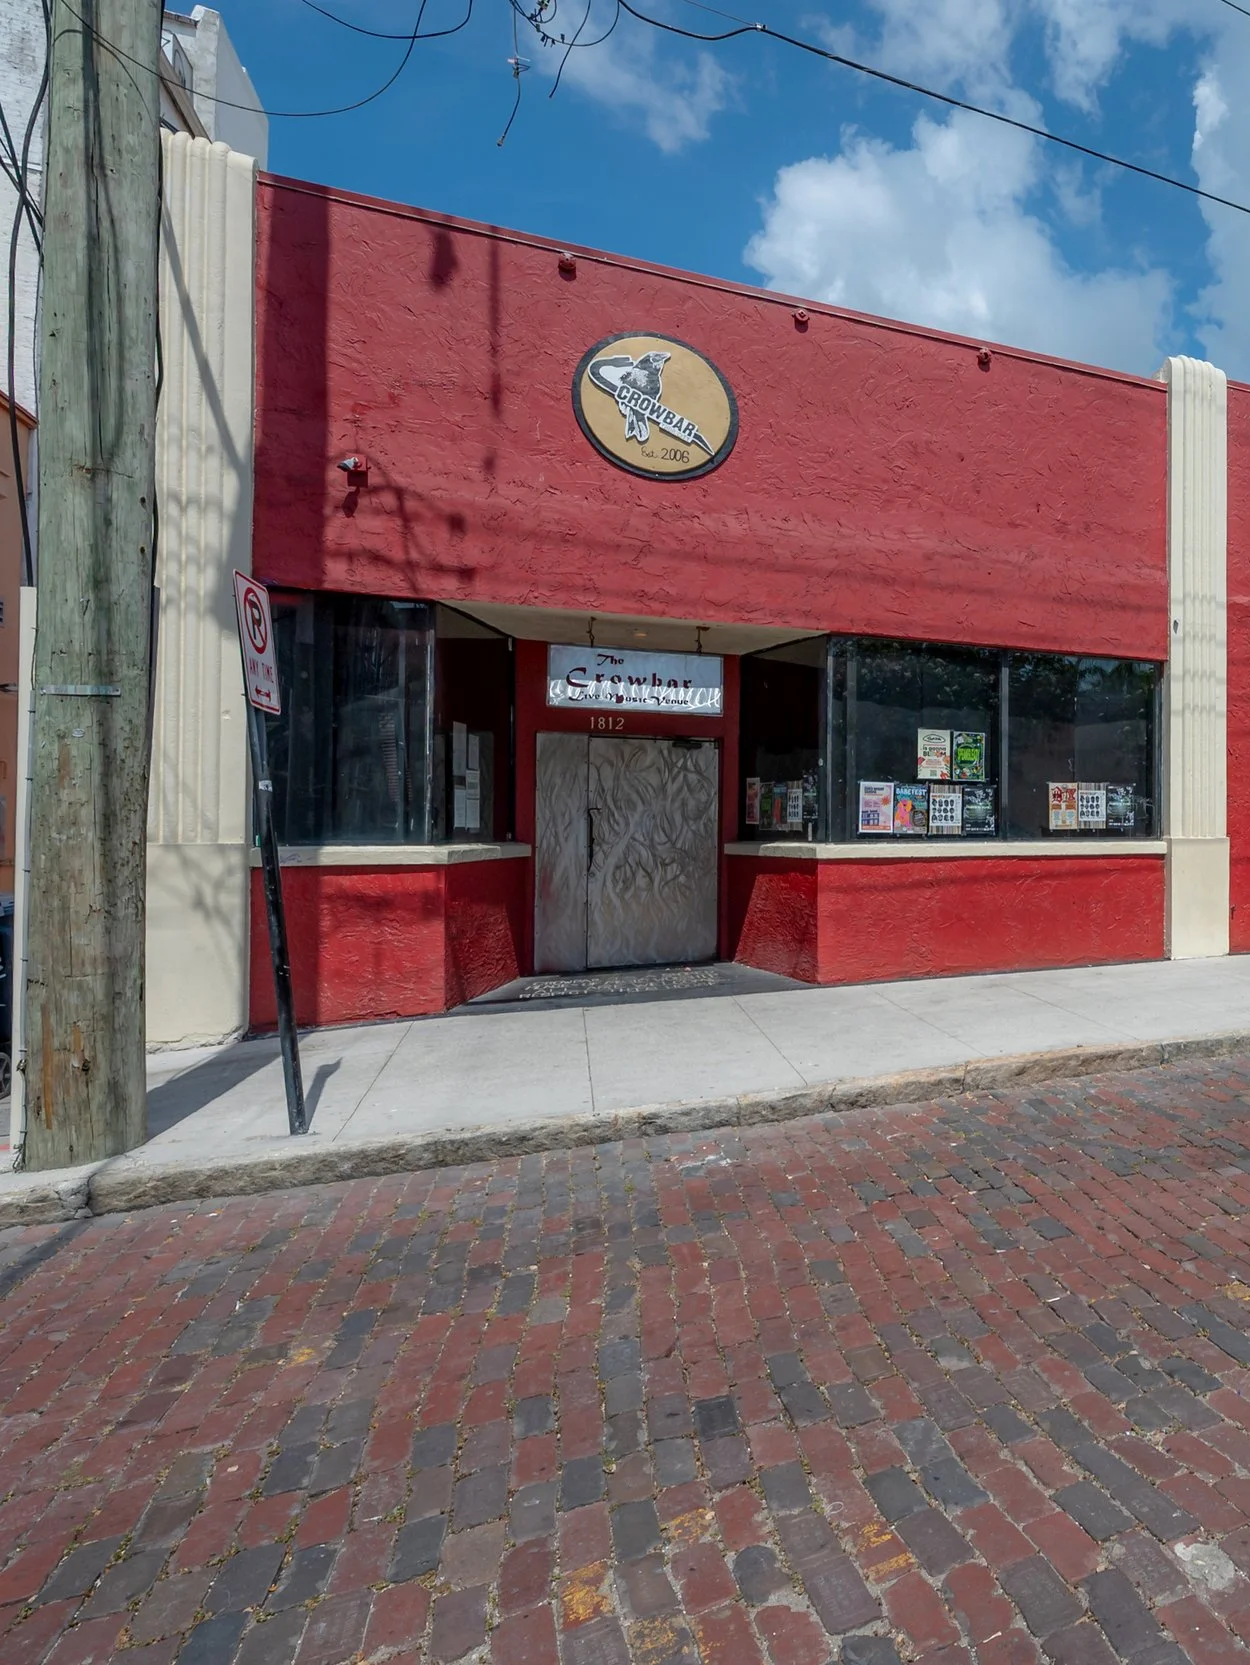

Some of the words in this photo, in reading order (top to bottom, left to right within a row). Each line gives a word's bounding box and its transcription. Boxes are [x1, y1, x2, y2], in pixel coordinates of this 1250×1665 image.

[617, 385, 698, 438] CROWBAR
[661, 448, 690, 463] 2006
[597, 653, 625, 666] The
[249, 657, 259, 678] ANY
[262, 662, 274, 684] TIME
[566, 667, 693, 689] Crowbar
[568, 690, 601, 702] Live
[650, 696, 689, 706] Venue
[589, 717, 625, 730] 1812
